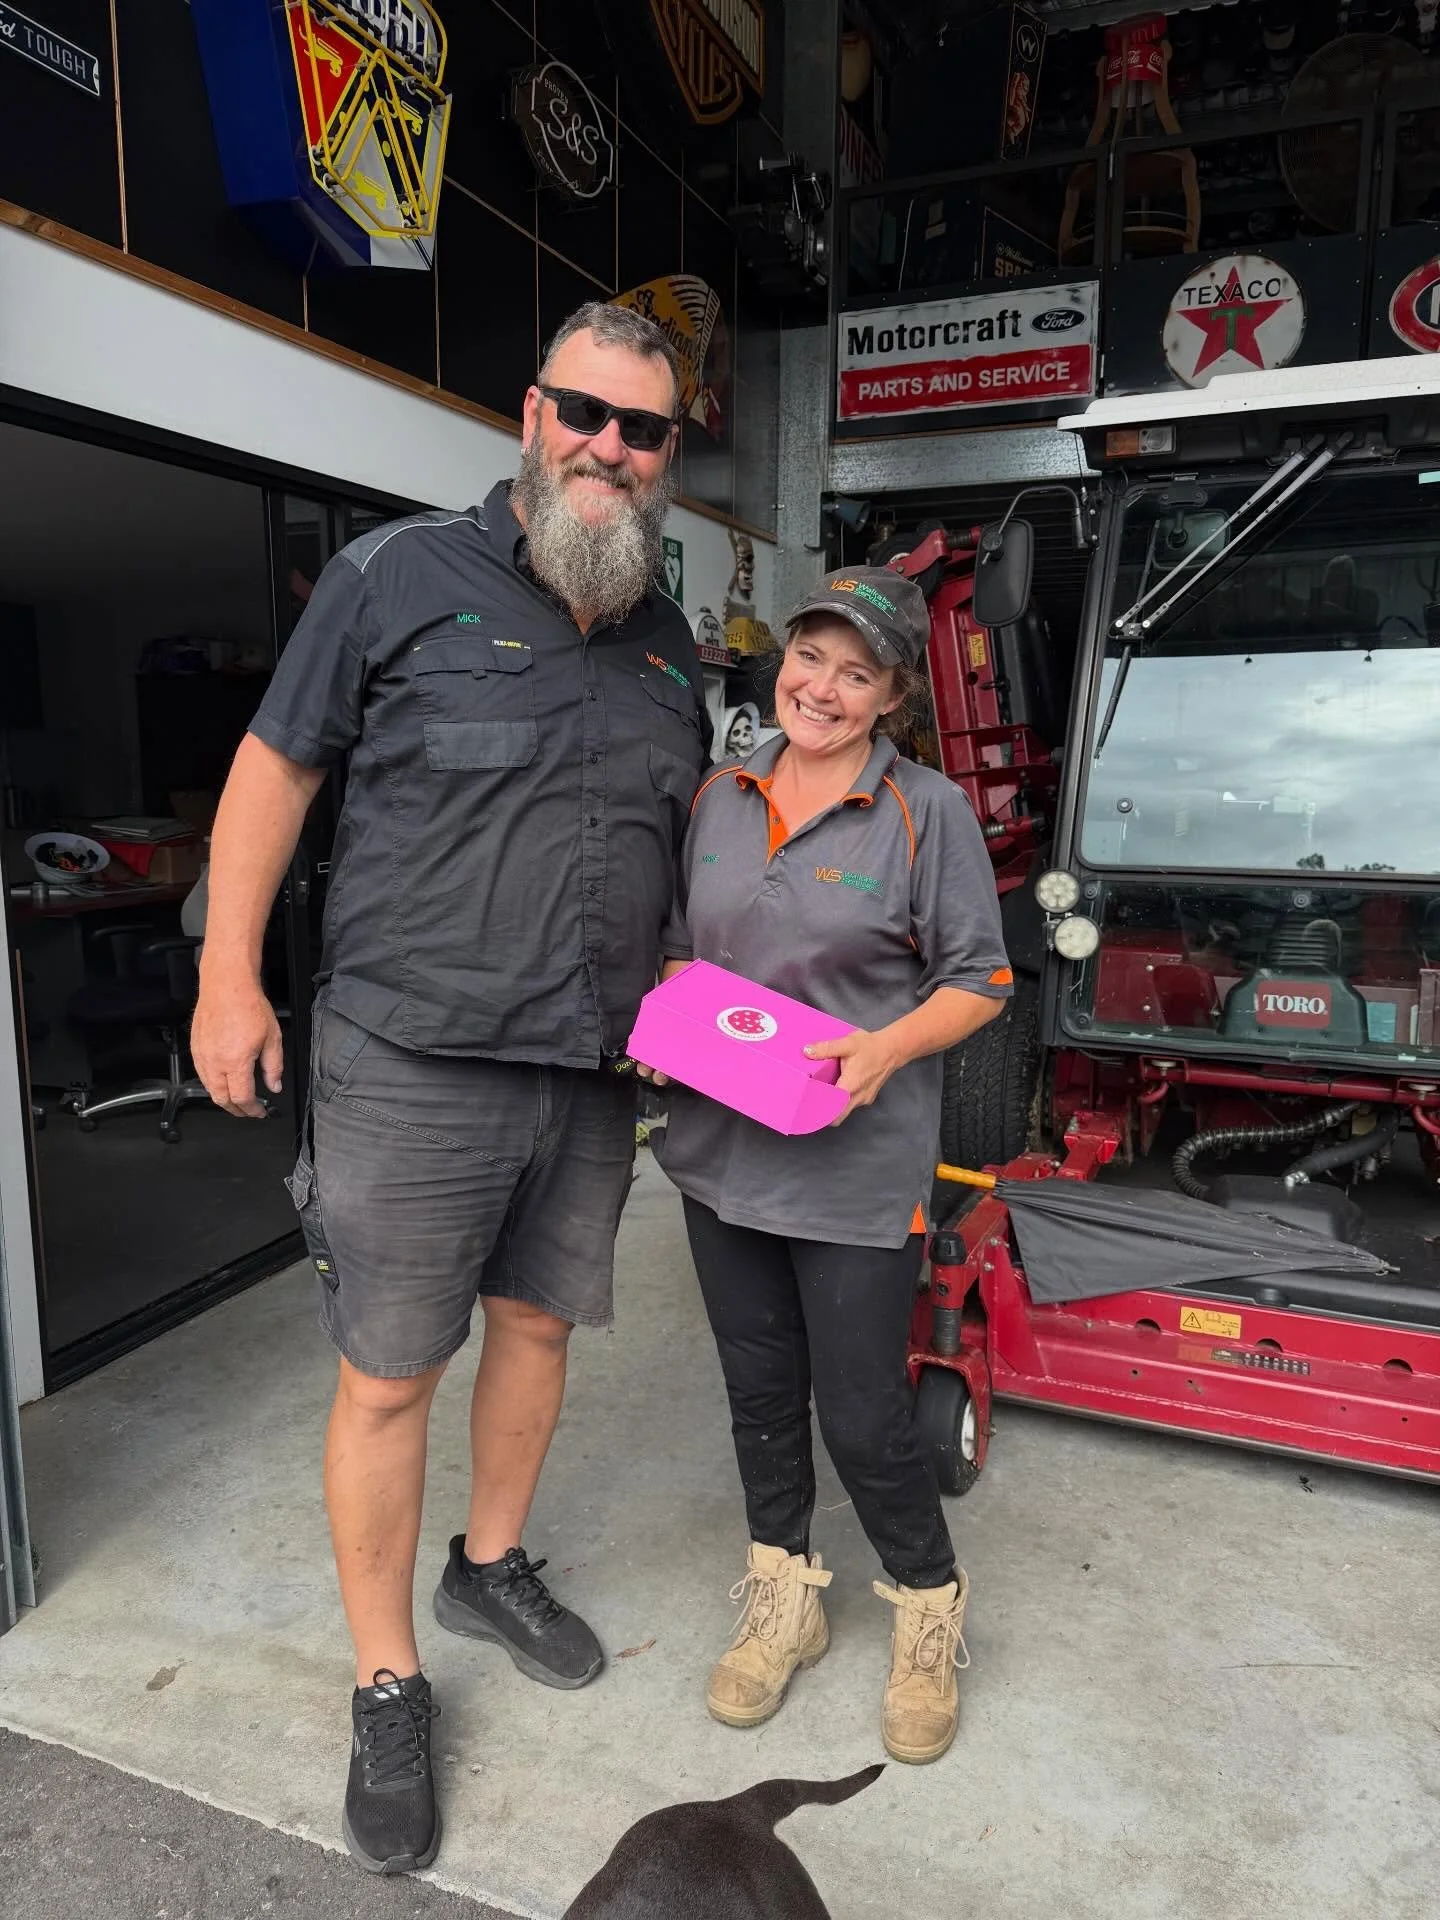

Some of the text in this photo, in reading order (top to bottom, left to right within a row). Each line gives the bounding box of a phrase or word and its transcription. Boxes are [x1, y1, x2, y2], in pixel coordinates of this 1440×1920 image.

[23, 25, 87, 80] TOUGH
[546, 97, 600, 166] S&S
[1183, 277, 1282, 307] TEXACO
[848, 309, 1022, 356] Motorcraft
[1041, 311, 1077, 329] Ford
[1210, 307, 1255, 351] T
[858, 361, 1071, 401] PARTS AND SERVICE
[858, 583, 897, 613] Walkabout
[457, 613, 481, 624] MICK
[815, 866, 842, 883] WS
[1262, 994, 1326, 1015] TORO
